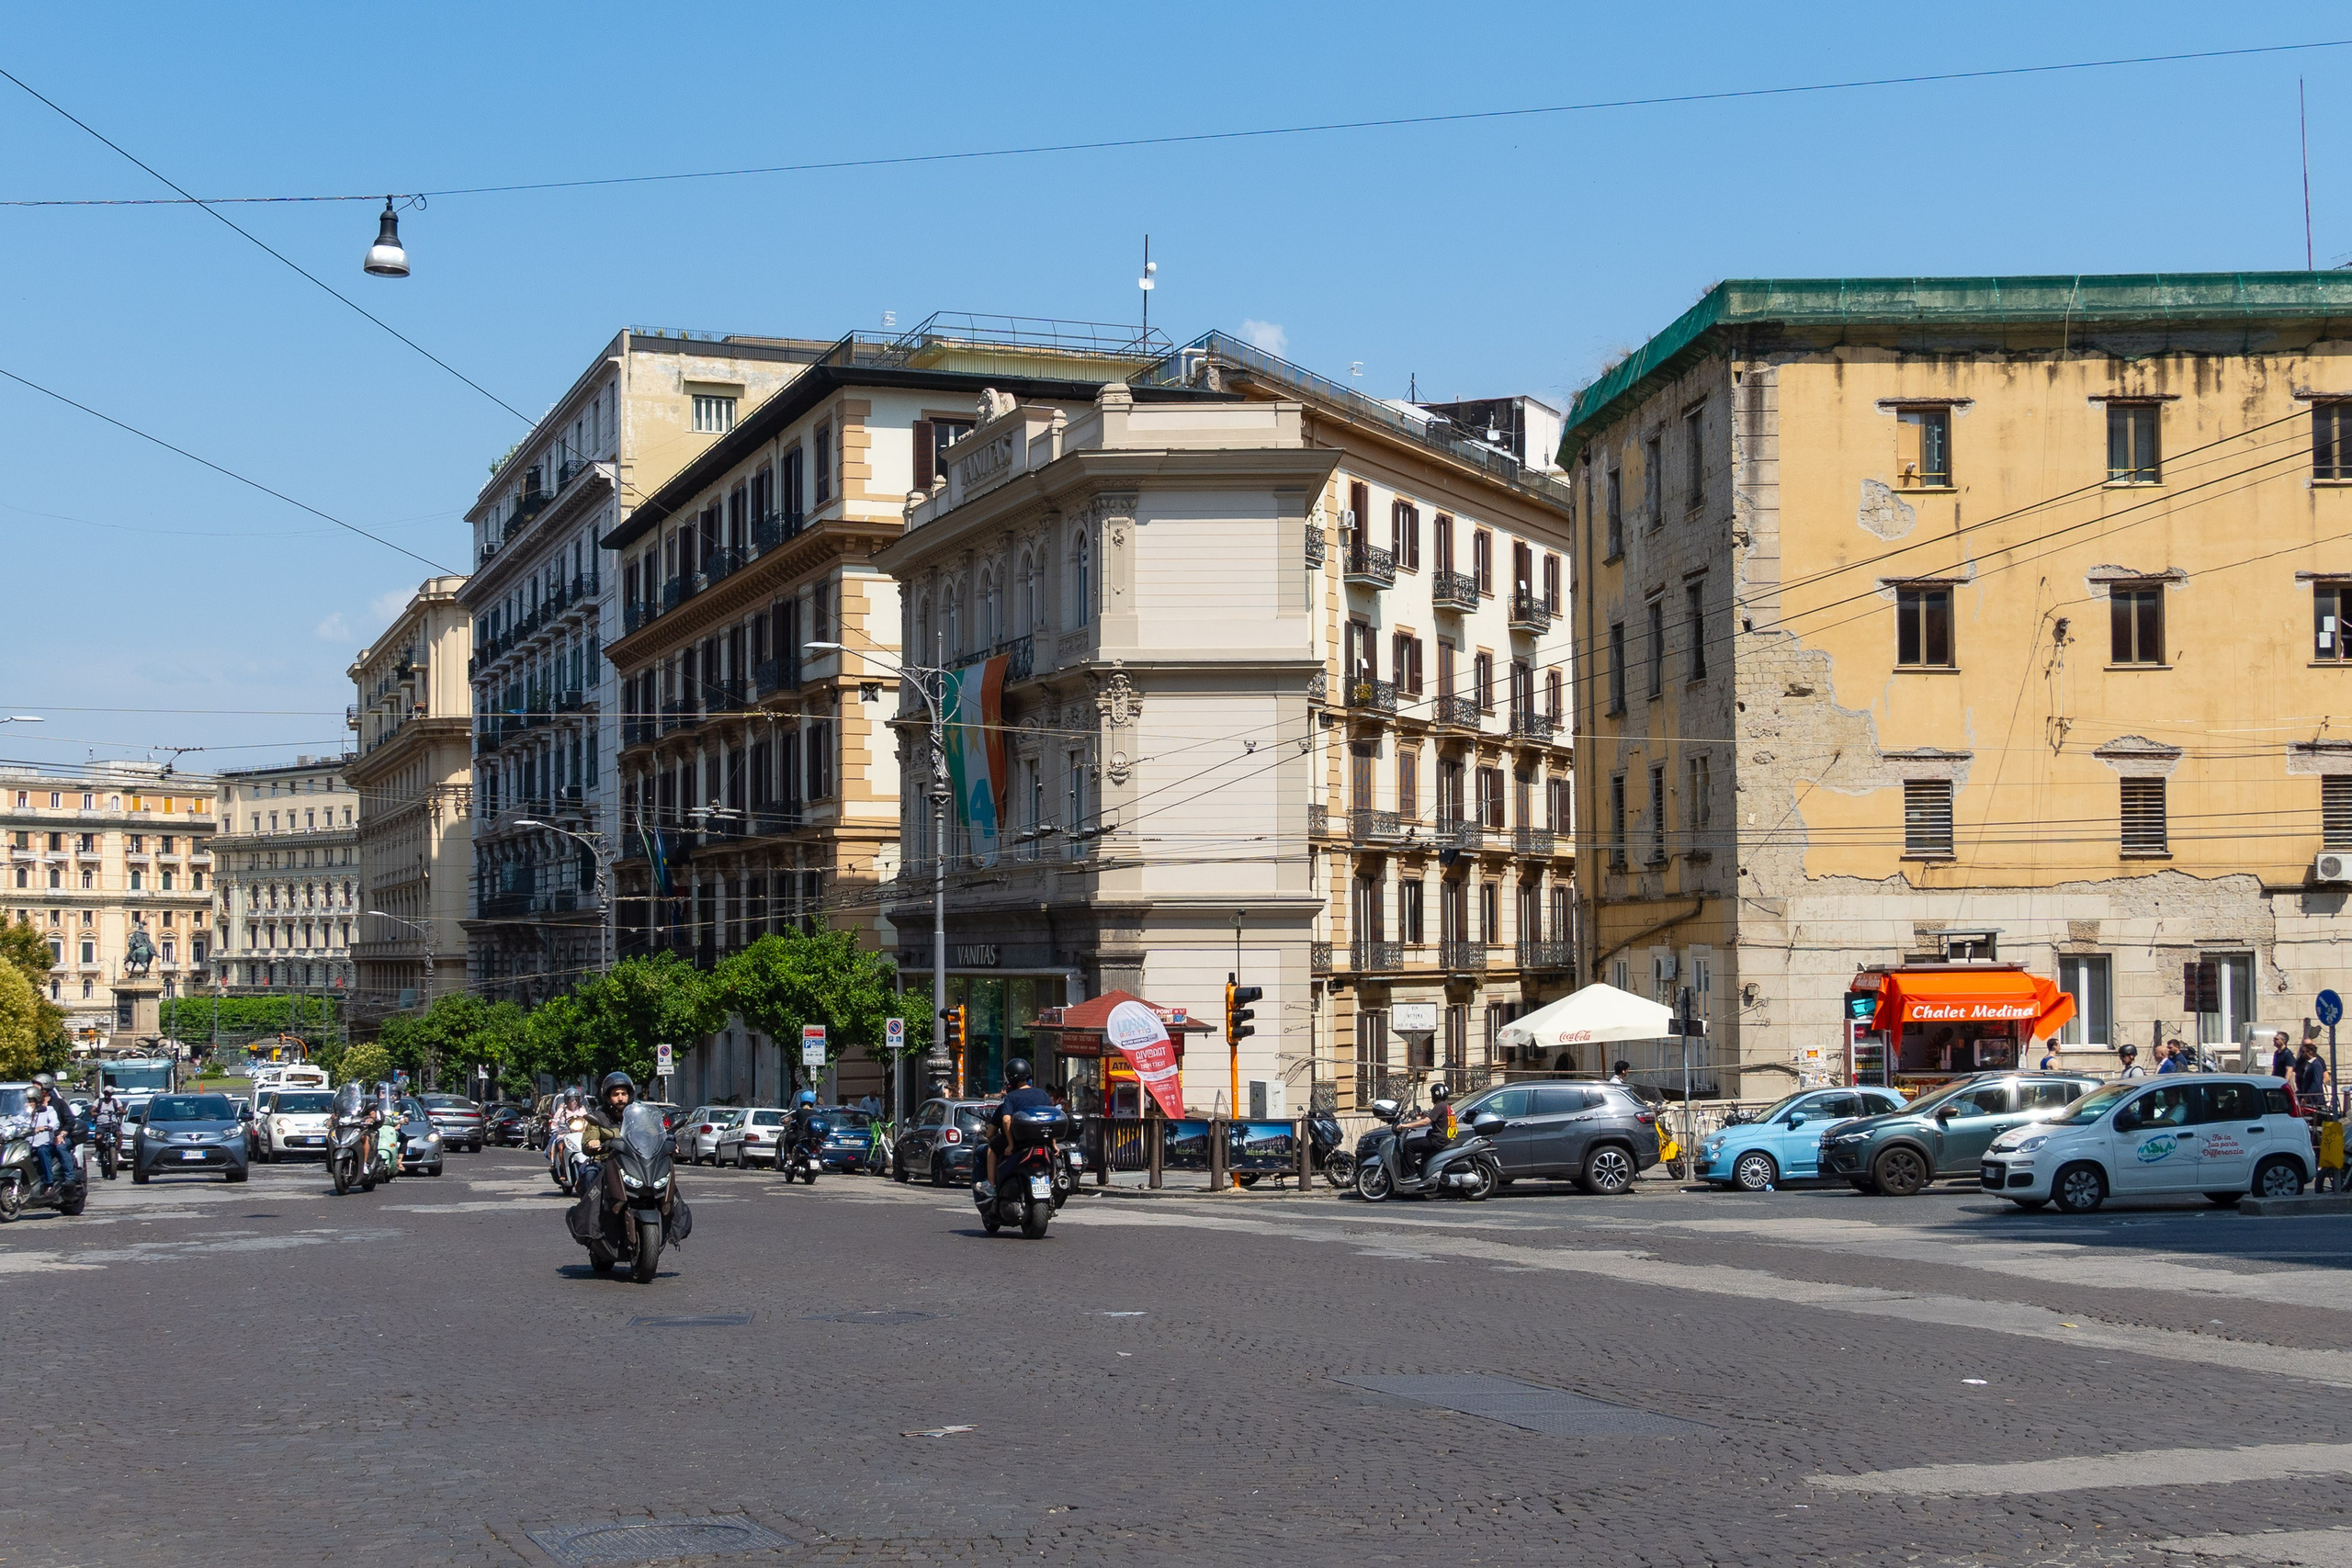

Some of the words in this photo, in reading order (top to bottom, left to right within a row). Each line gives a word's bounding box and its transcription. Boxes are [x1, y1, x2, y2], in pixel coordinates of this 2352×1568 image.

[960, 434, 1012, 487] VANITAS
[969, 778, 996, 839] 4
[957, 944, 996, 965] VANITAS
[1912, 1005, 1966, 1019] Chalet
[1971, 1004, 2033, 1018] Medina
[1112, 1062, 1133, 1071] ATM
[2220, 1141, 2239, 1149] parte
[2201, 1148, 2245, 1158] Differenzia
[1033, 1185, 1049, 1193] 91732
